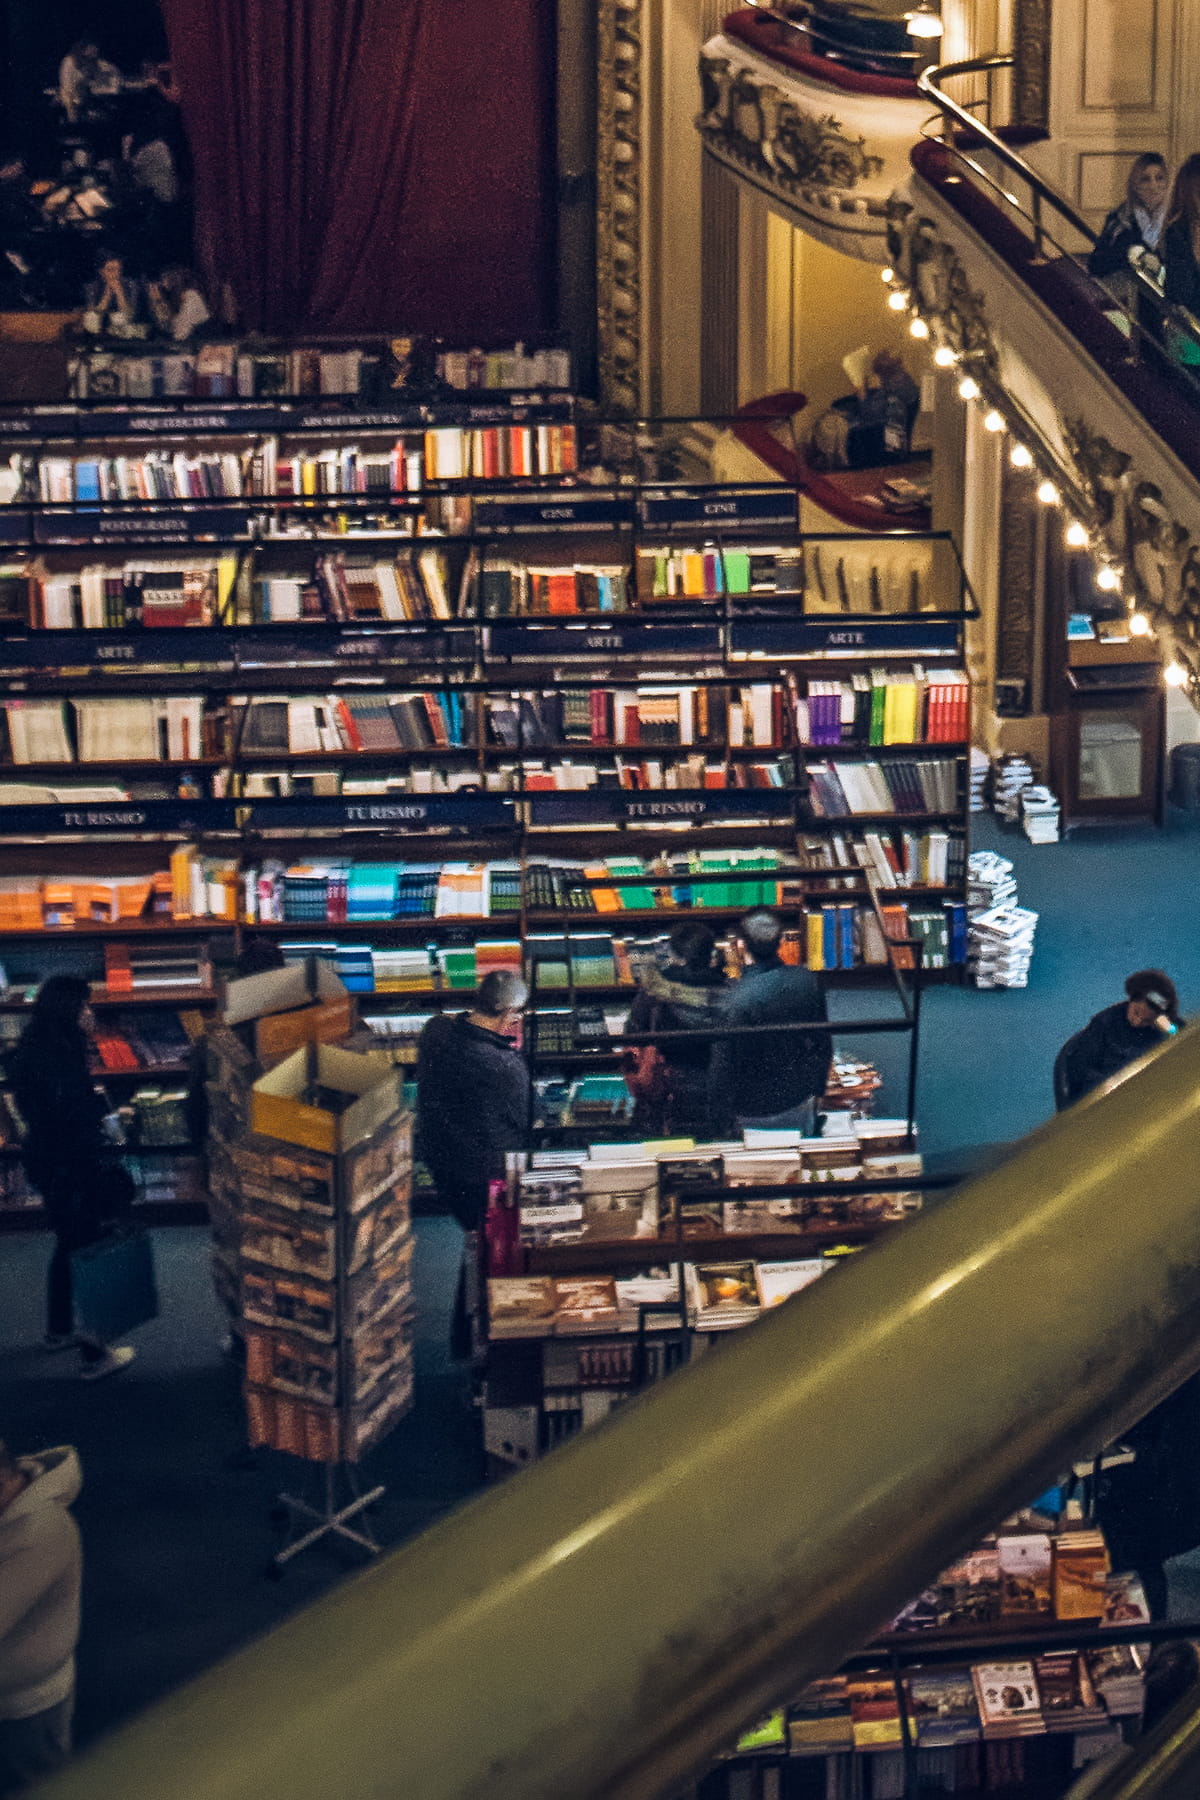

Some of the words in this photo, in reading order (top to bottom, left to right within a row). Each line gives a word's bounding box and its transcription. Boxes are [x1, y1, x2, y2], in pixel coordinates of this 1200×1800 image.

[584, 634, 624, 649] ARTE
[825, 630, 866, 646] ARTE
[95, 645, 136, 660] ARTE
[345, 805, 427, 821] TURISMO
[625, 800, 708, 817] TURISMO
[63, 810, 146, 826] TURISMO
